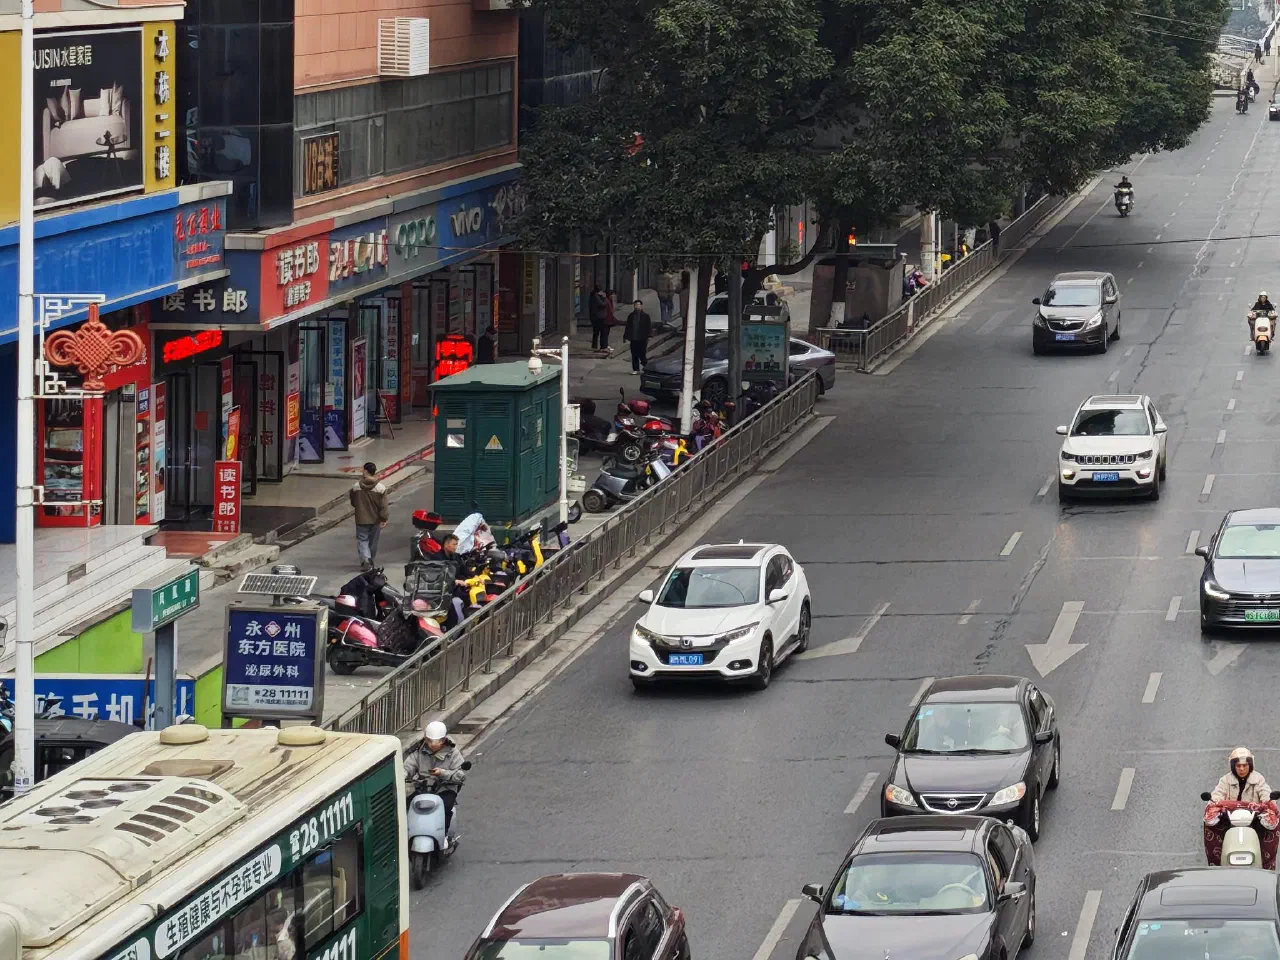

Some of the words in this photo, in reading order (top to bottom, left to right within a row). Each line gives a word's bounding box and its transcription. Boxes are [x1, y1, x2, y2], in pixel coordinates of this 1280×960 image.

[451, 204, 484, 236] vivo
[276, 241, 320, 285] 读书郎
[162, 287, 248, 314] 读书郎
[218, 468, 236, 516] 读书郎
[238, 639, 306, 657] 东方医院
[245, 663, 300, 679] 泌尿外科
[261, 688, 277, 699] 28
[279, 689, 309, 700] 11111
[300, 819, 319, 856] 28
[319, 791, 355, 839] 11111
[165, 852, 274, 951] 生殖健康与不孕症专业
